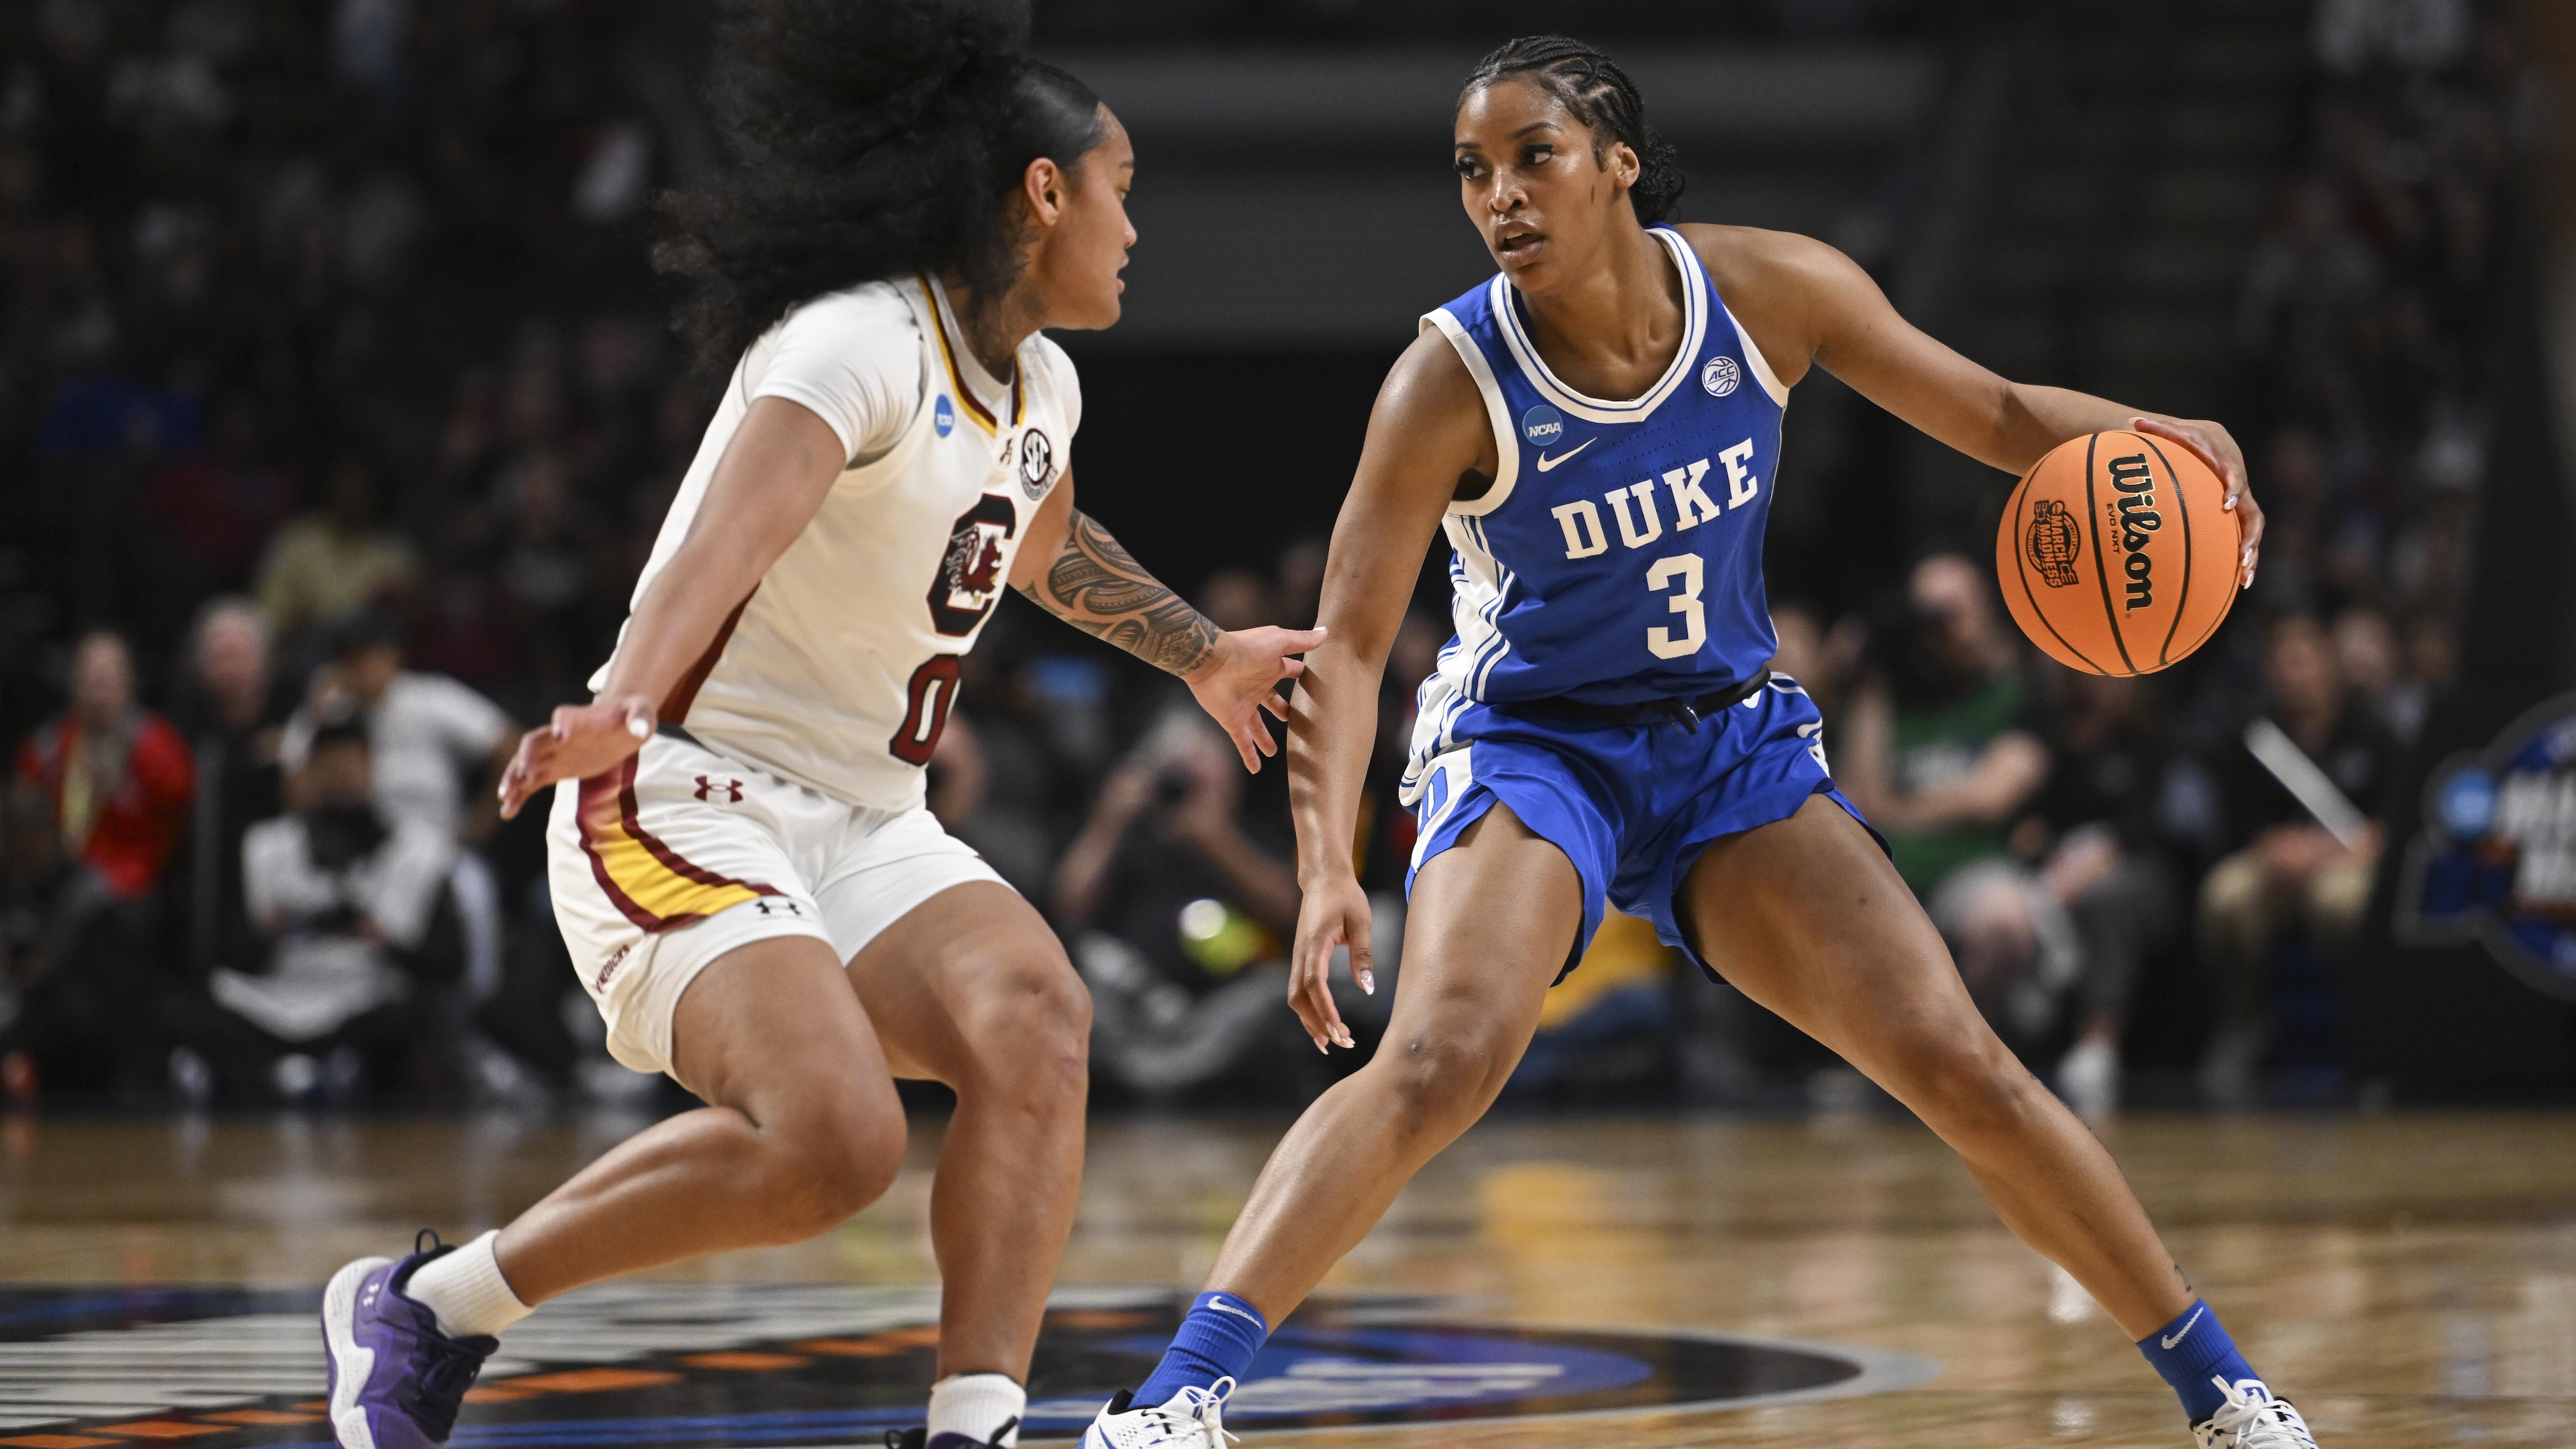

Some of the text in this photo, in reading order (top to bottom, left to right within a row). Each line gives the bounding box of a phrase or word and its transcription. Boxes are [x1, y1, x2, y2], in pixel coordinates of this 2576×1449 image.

[1708, 364, 1736, 382] ACC
[1528, 421, 1562, 438] NCAA
[1550, 437, 1758, 559] DUKE
[2106, 502, 2121, 555] EVO NXT
[2039, 523, 2061, 587] MADNESS
[2050, 515, 2068, 562] MARCH
[2108, 453, 2163, 612] Wilson
[1646, 553, 1707, 660] 3
[888, 653, 961, 768] 0
